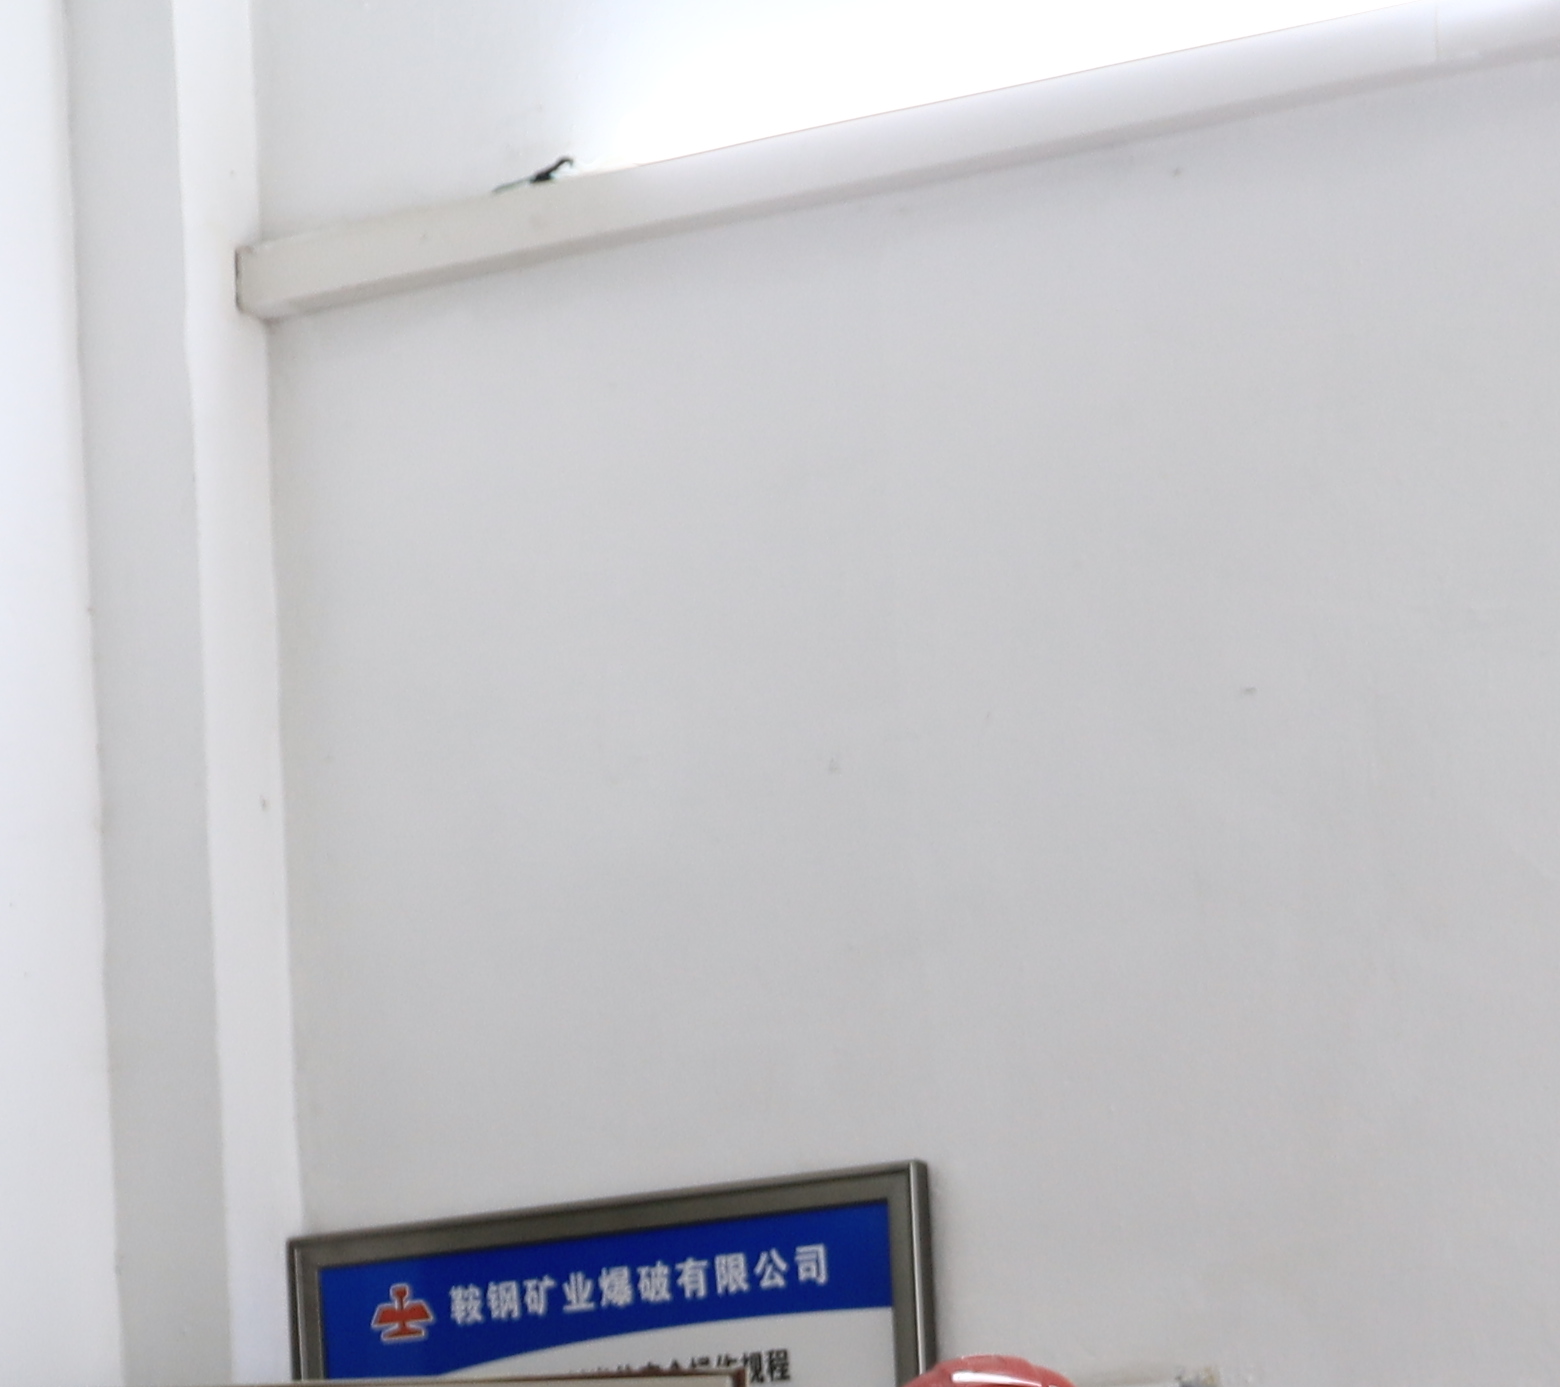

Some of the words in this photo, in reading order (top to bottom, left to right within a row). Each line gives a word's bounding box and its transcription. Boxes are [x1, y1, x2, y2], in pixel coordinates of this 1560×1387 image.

[449, 1242, 830, 1325] 鞍钢矿业爆破有限公司
